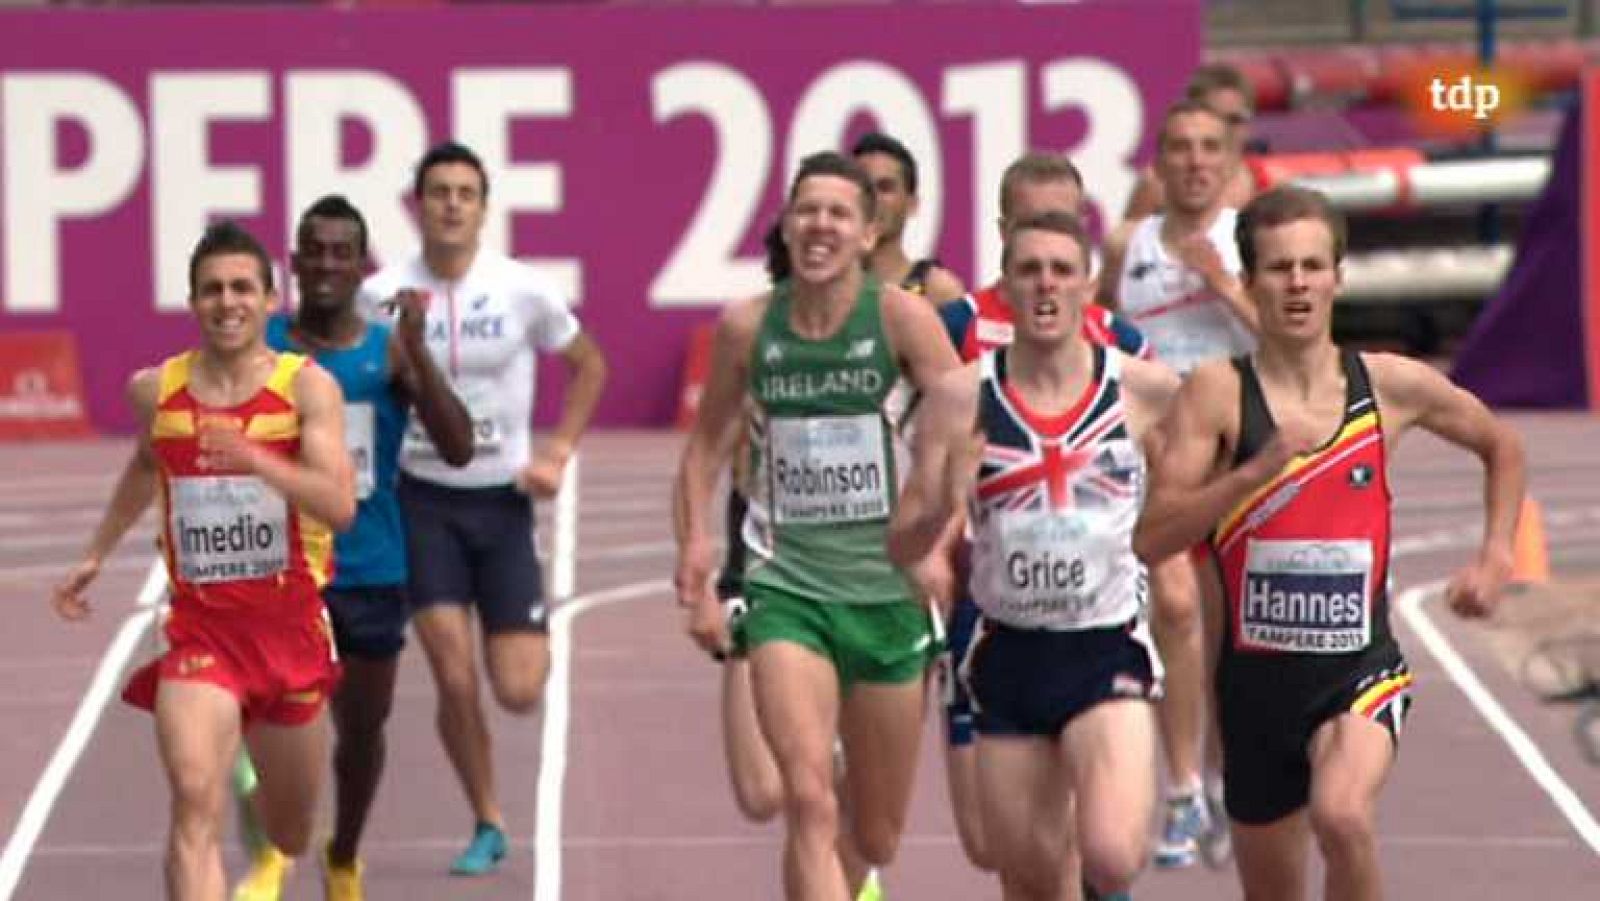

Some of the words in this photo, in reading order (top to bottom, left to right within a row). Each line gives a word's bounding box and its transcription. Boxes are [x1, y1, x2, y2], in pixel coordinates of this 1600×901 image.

[649, 58, 1144, 308] 2013
[763, 369, 883, 399] IRELAND
[776, 458, 881, 495] Robinson
[177, 512, 273, 554] Imedio
[1008, 551, 1085, 589] Grice
[1248, 579, 1361, 623] Hannes
[1248, 626, 1325, 647] TAMPERE
